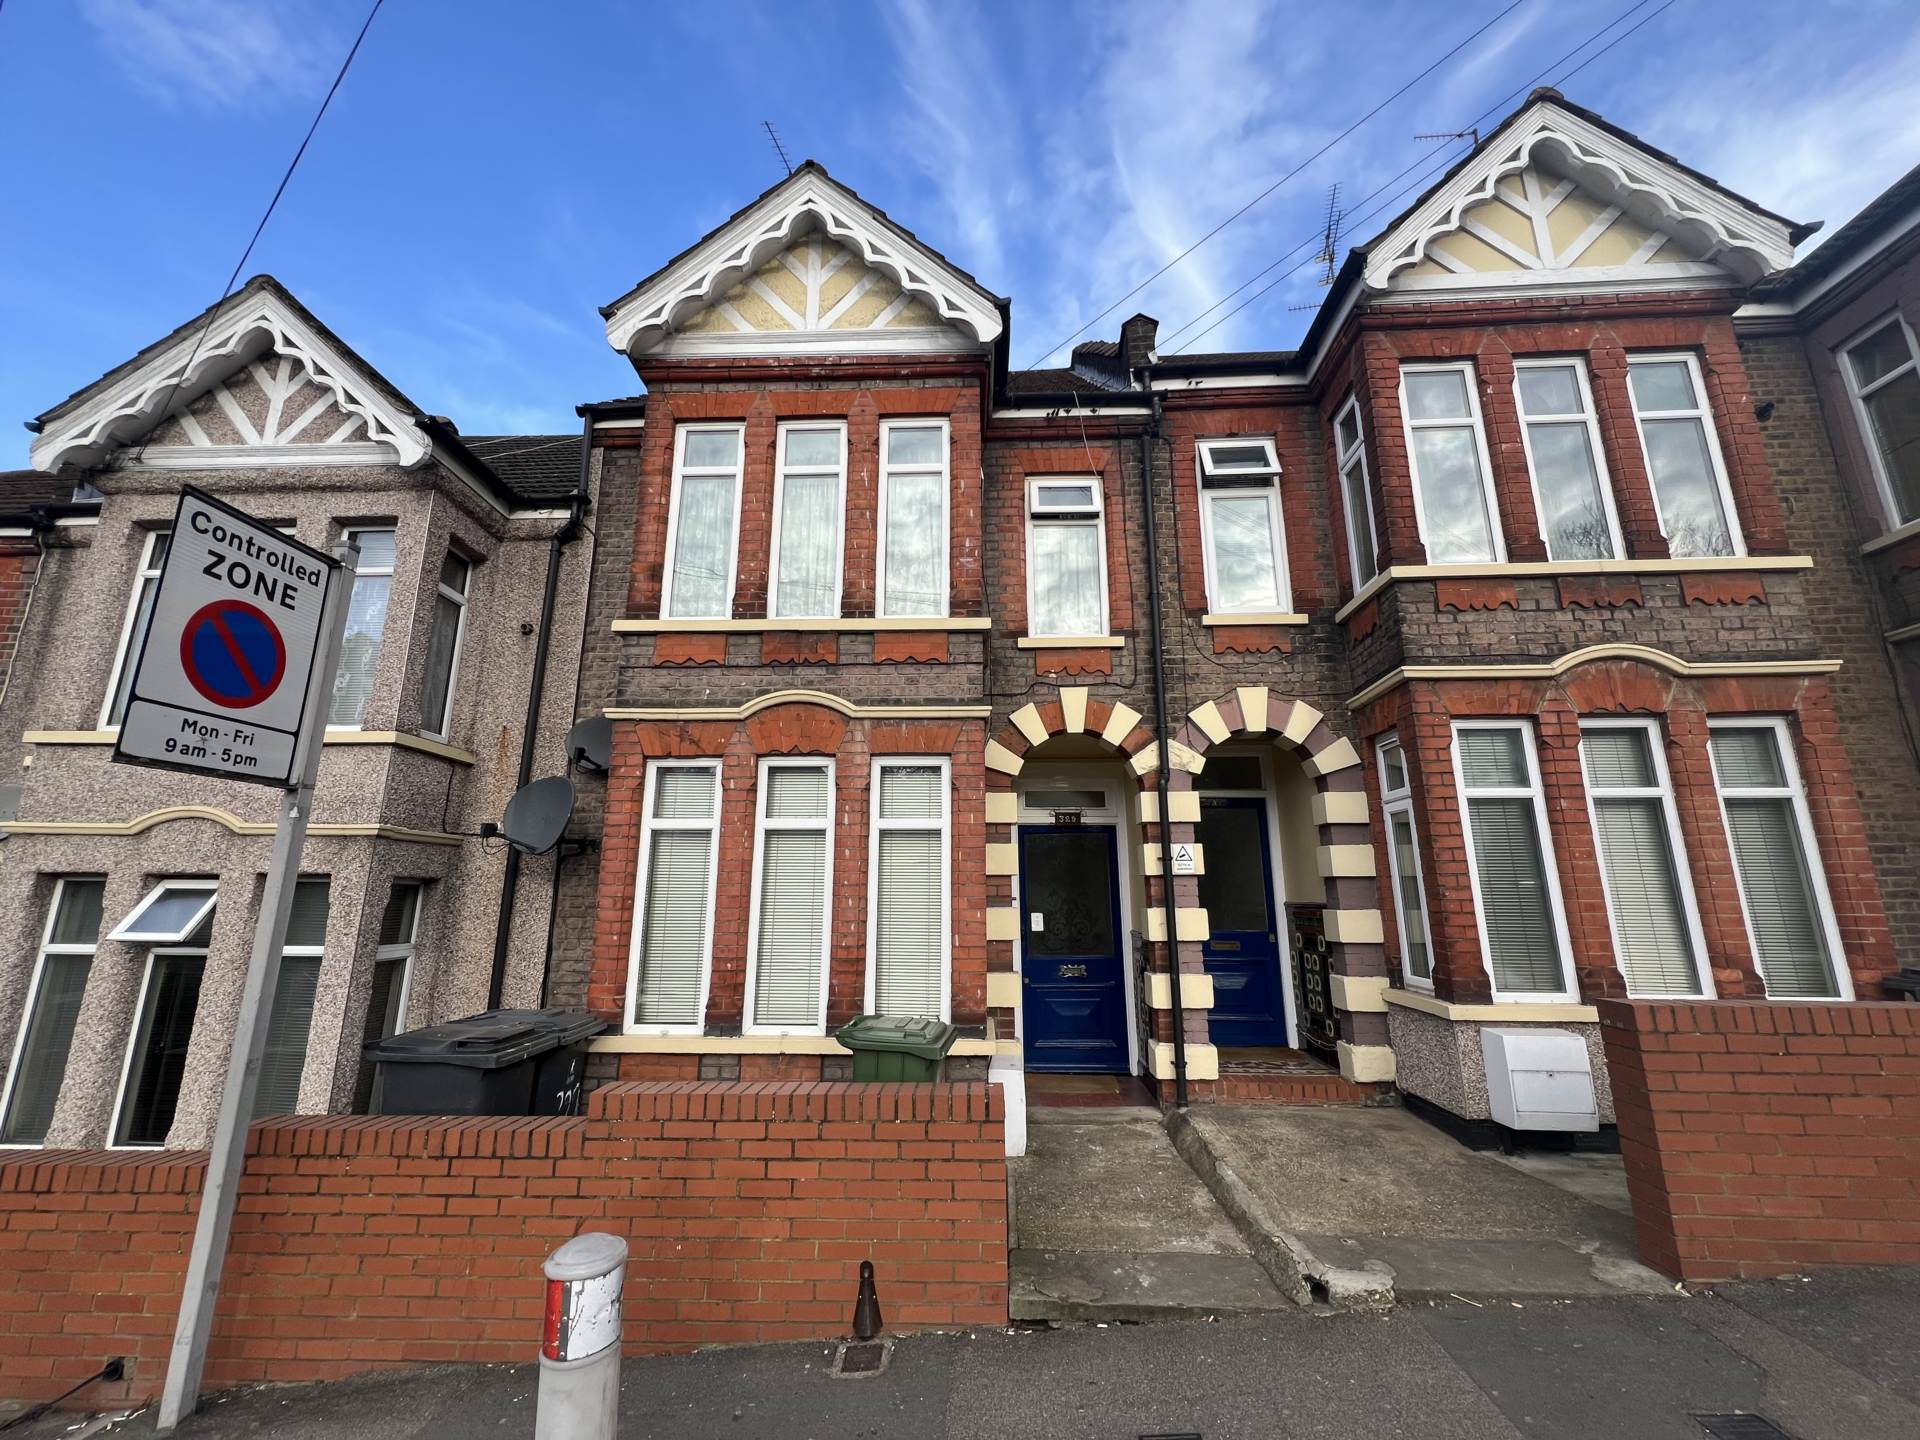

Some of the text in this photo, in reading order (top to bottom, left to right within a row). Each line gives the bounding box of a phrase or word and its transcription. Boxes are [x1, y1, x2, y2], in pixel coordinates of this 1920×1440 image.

[191, 511, 321, 587] Controlled
[203, 549, 298, 611] ZONE
[181, 718, 219, 739] Mon
[233, 729, 255, 746] Fri
